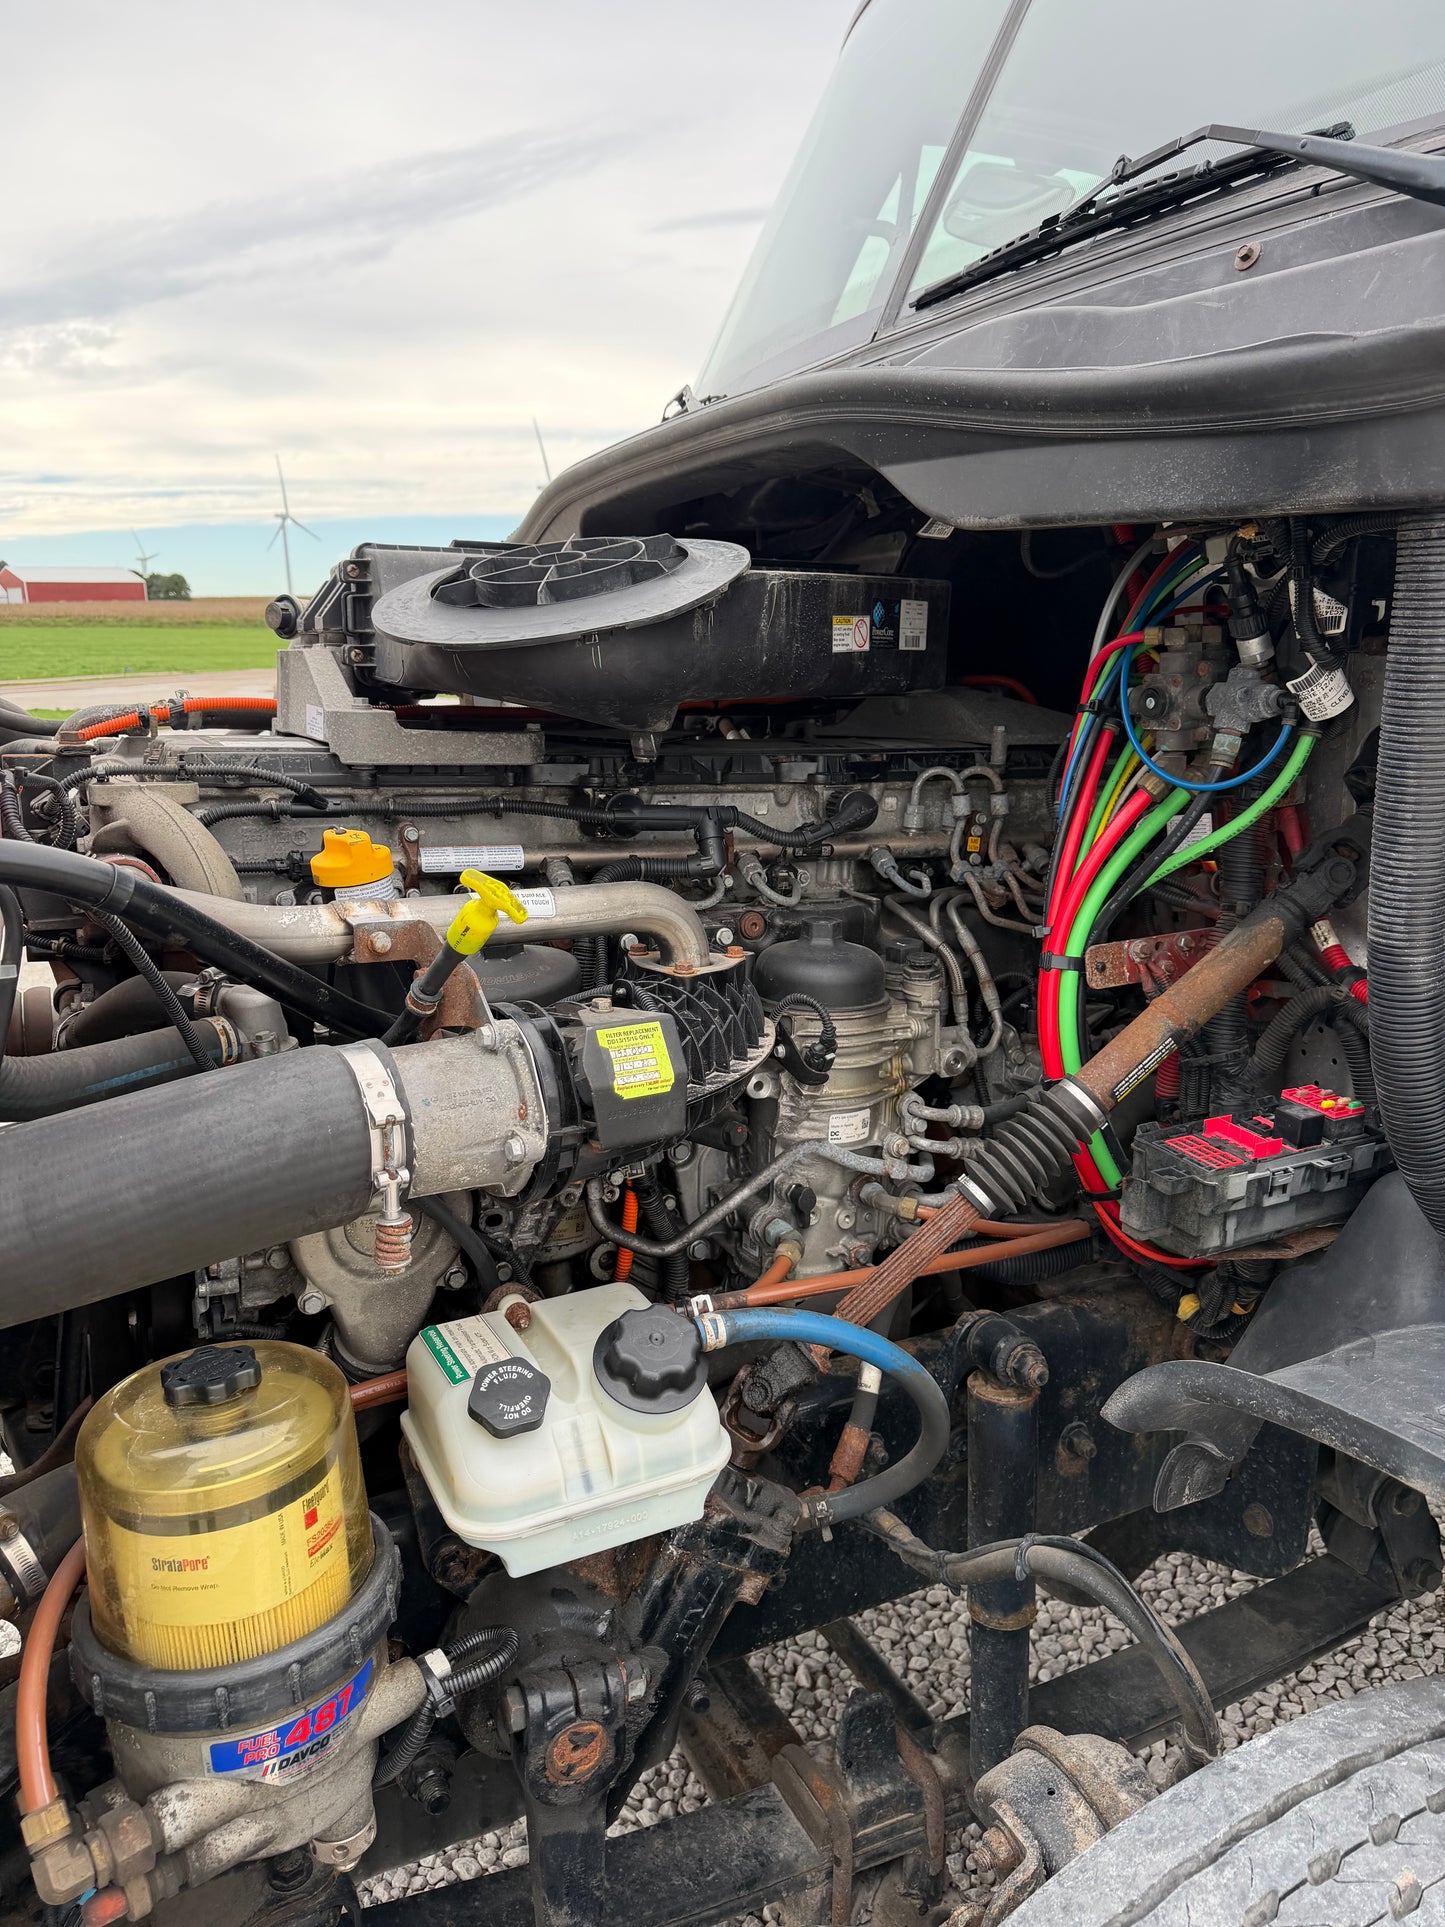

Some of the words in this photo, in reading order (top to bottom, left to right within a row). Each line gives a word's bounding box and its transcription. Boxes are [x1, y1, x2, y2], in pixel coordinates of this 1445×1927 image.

[623, 1027, 659, 1037] REPLACEMENT
[427, 1330, 444, 1350] Reservoir
[438, 1346, 456, 1367] Steering
[451, 1364, 465, 1379] Power
[480, 1370, 498, 1391] POWER
[498, 1365, 534, 1379] STEERING
[493, 1372, 518, 1384] FLUID
[499, 1395, 532, 1412] OVERFILL
[521, 1408, 532, 1416] DO
[302, 1479, 329, 1513] Fleetguard
[571, 1511, 648, 1541] A14-17924-000
[284, 1682, 354, 1748] 487
[237, 1730, 281, 1754] FUEL
[277, 1733, 332, 1771] DAVCO
[243, 1743, 280, 1766] PRO
